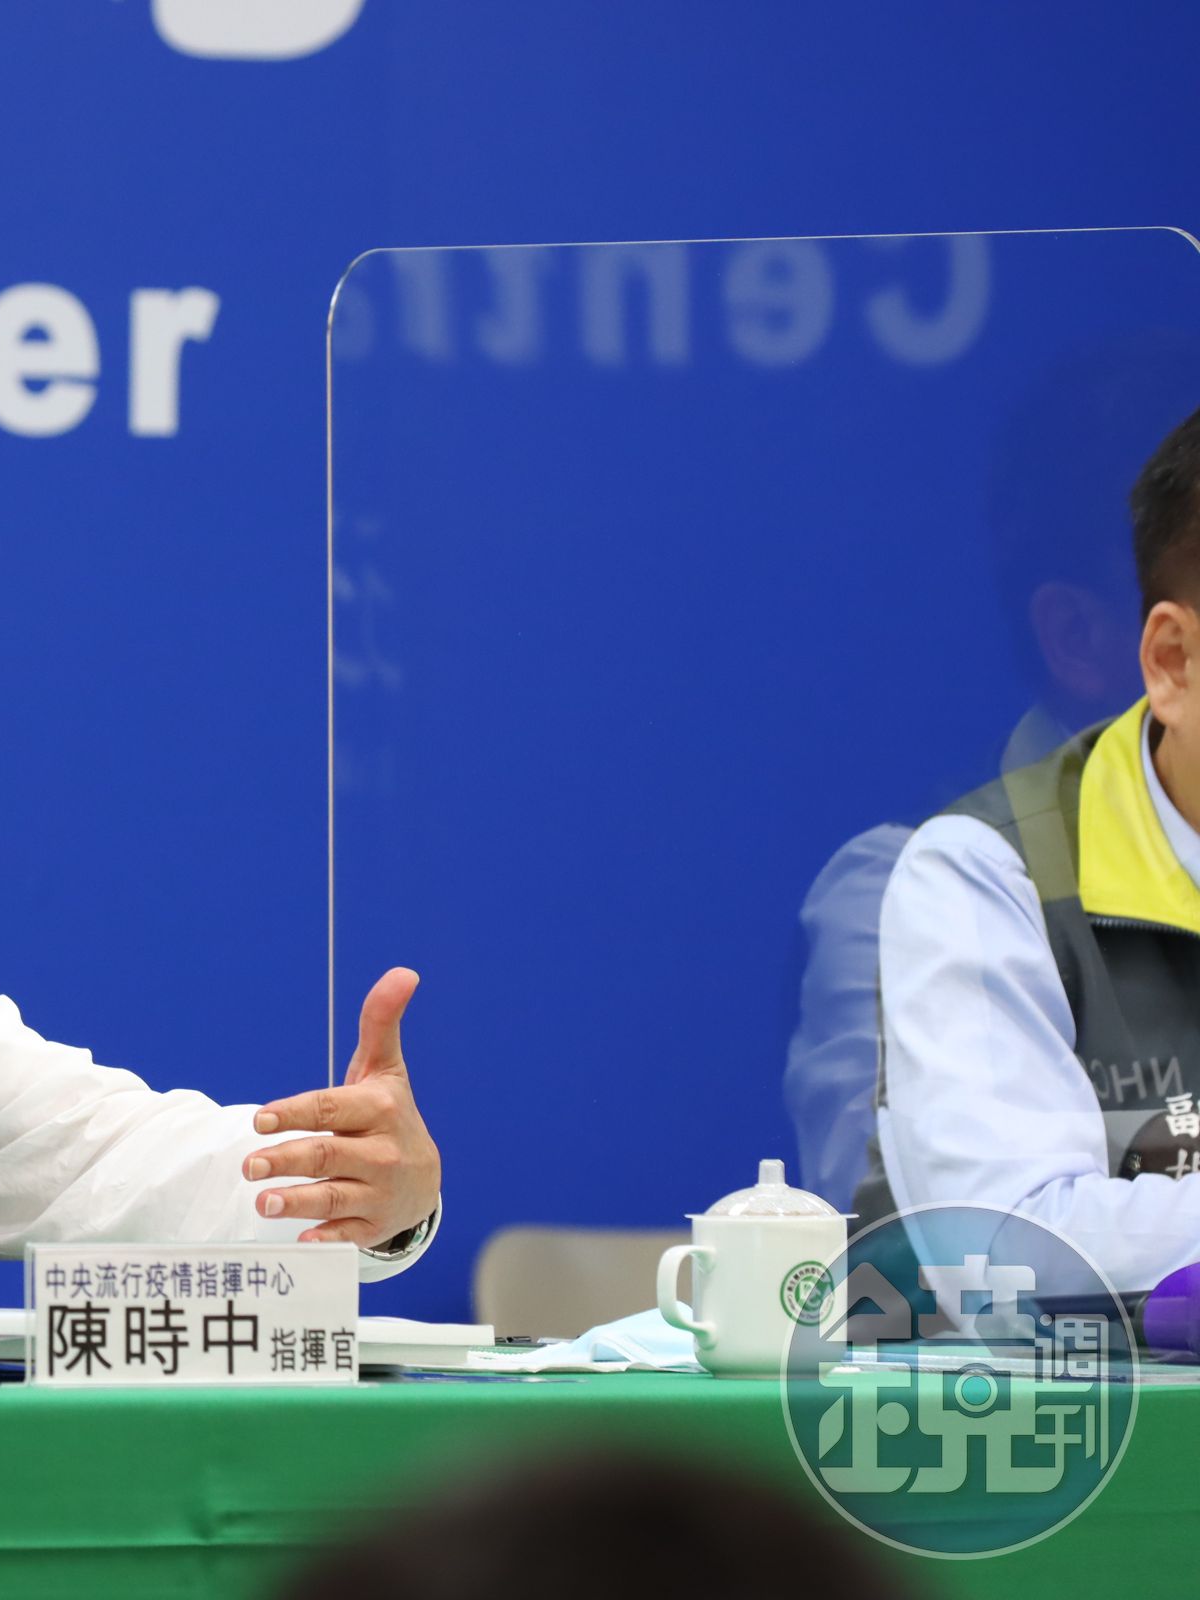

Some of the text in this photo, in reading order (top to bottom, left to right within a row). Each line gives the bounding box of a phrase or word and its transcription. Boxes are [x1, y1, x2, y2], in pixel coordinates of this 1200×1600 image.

[45, 1261, 295, 1300] 中央流行疫情指揮中心
[48, 1300, 356, 1377] 陳時中 指揮官
